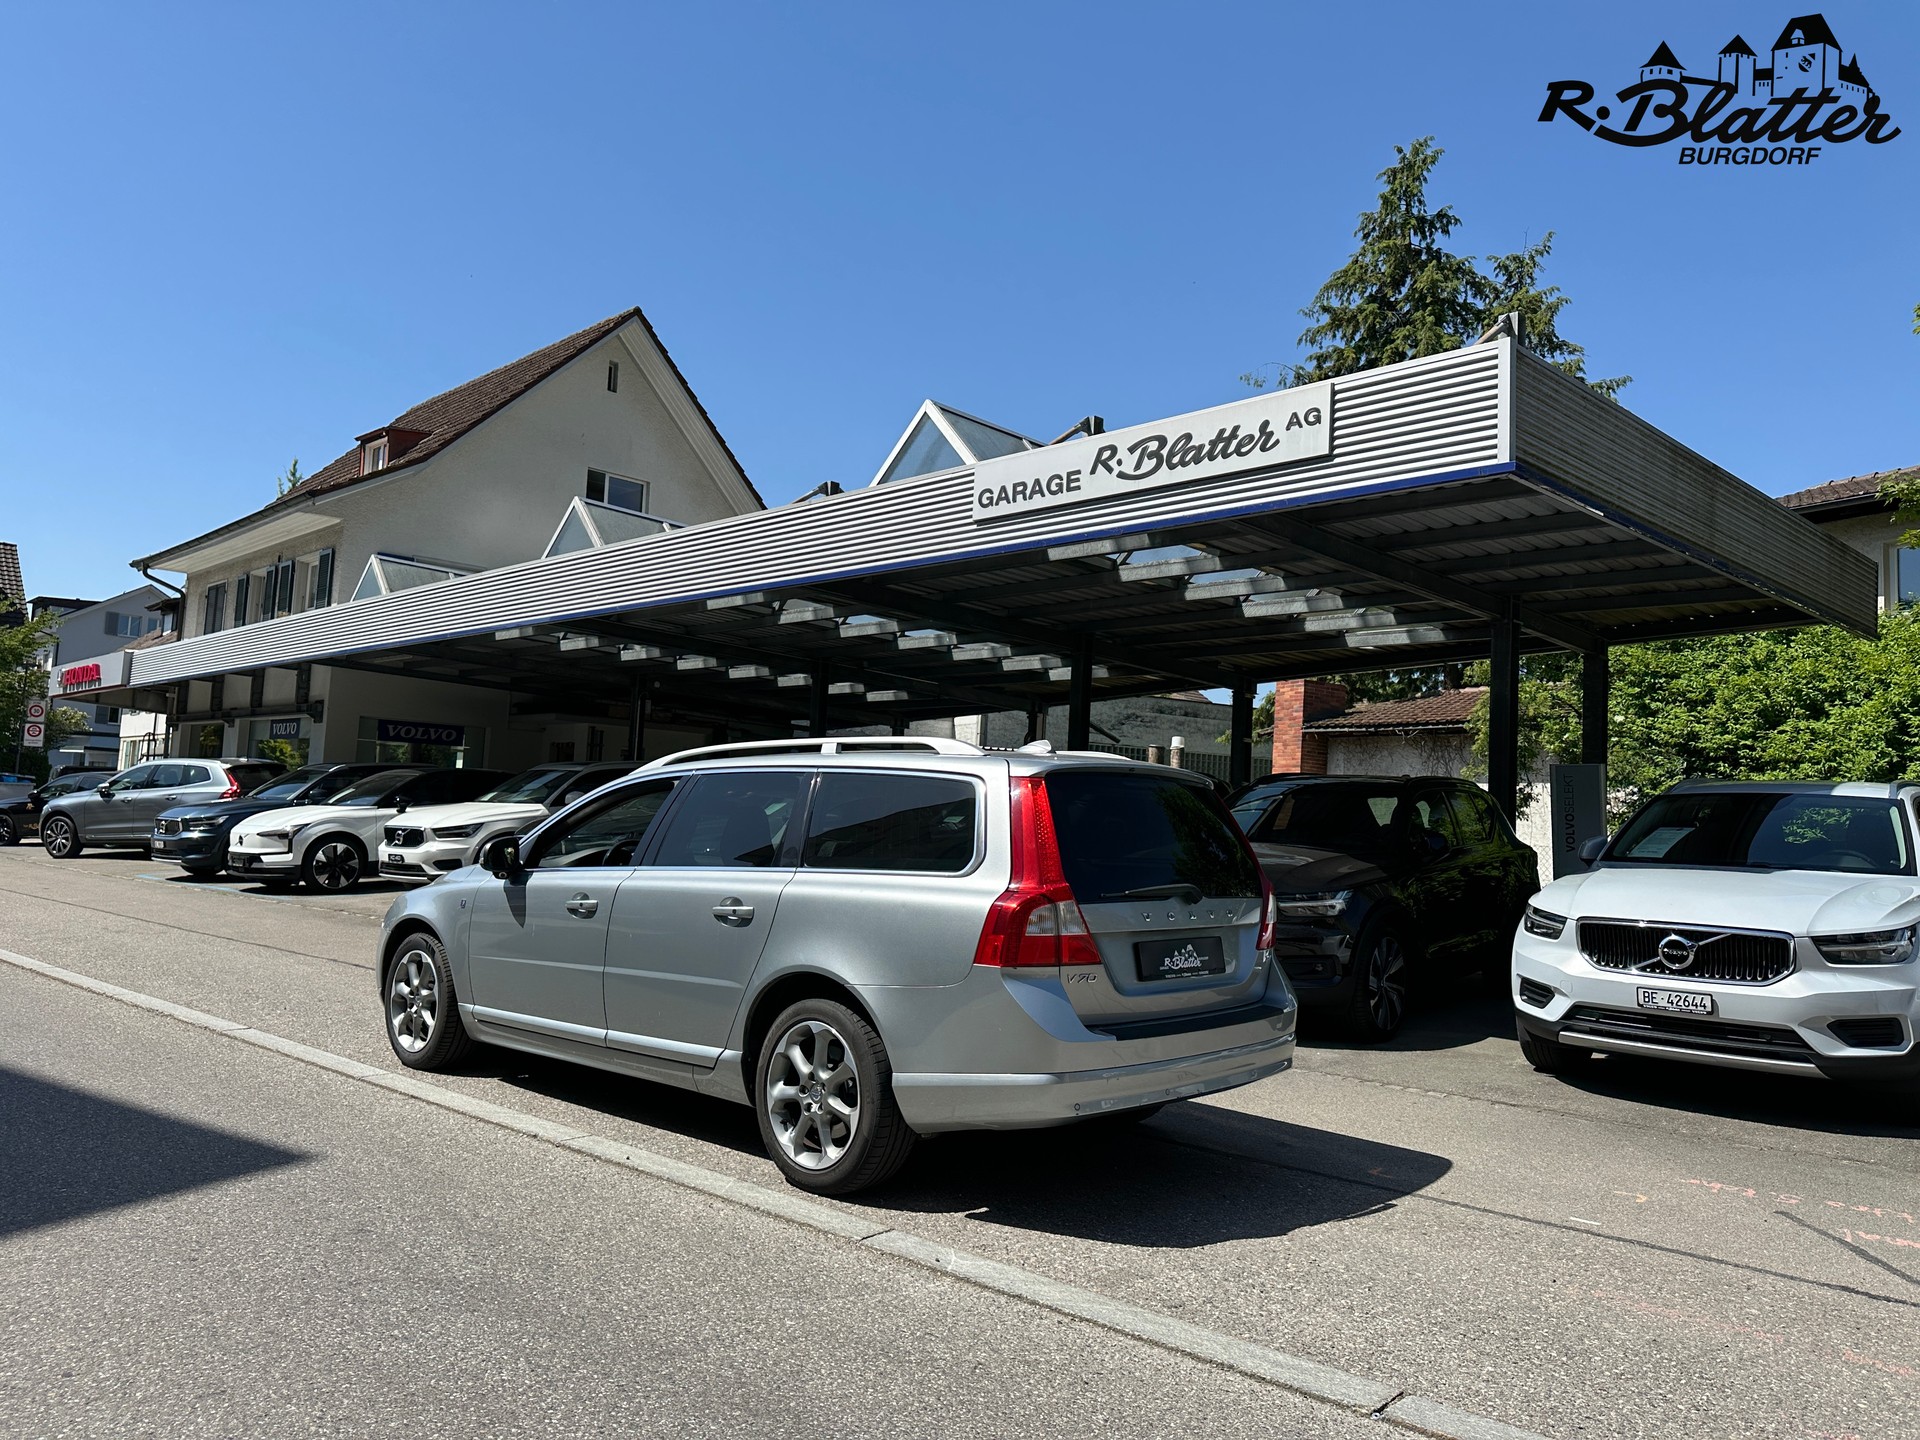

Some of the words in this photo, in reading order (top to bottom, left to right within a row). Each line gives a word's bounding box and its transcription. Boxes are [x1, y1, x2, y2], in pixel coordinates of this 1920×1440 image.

[978, 469, 1082, 508] GARAGE
[1286, 407, 1322, 431] AG
[64, 664, 101, 686] HONDA
[272, 722, 297, 735] VOLVO
[386, 724, 457, 741] VOLVO
[1141, 909, 1234, 922] VOLVO
[1066, 973, 1098, 984] V70
